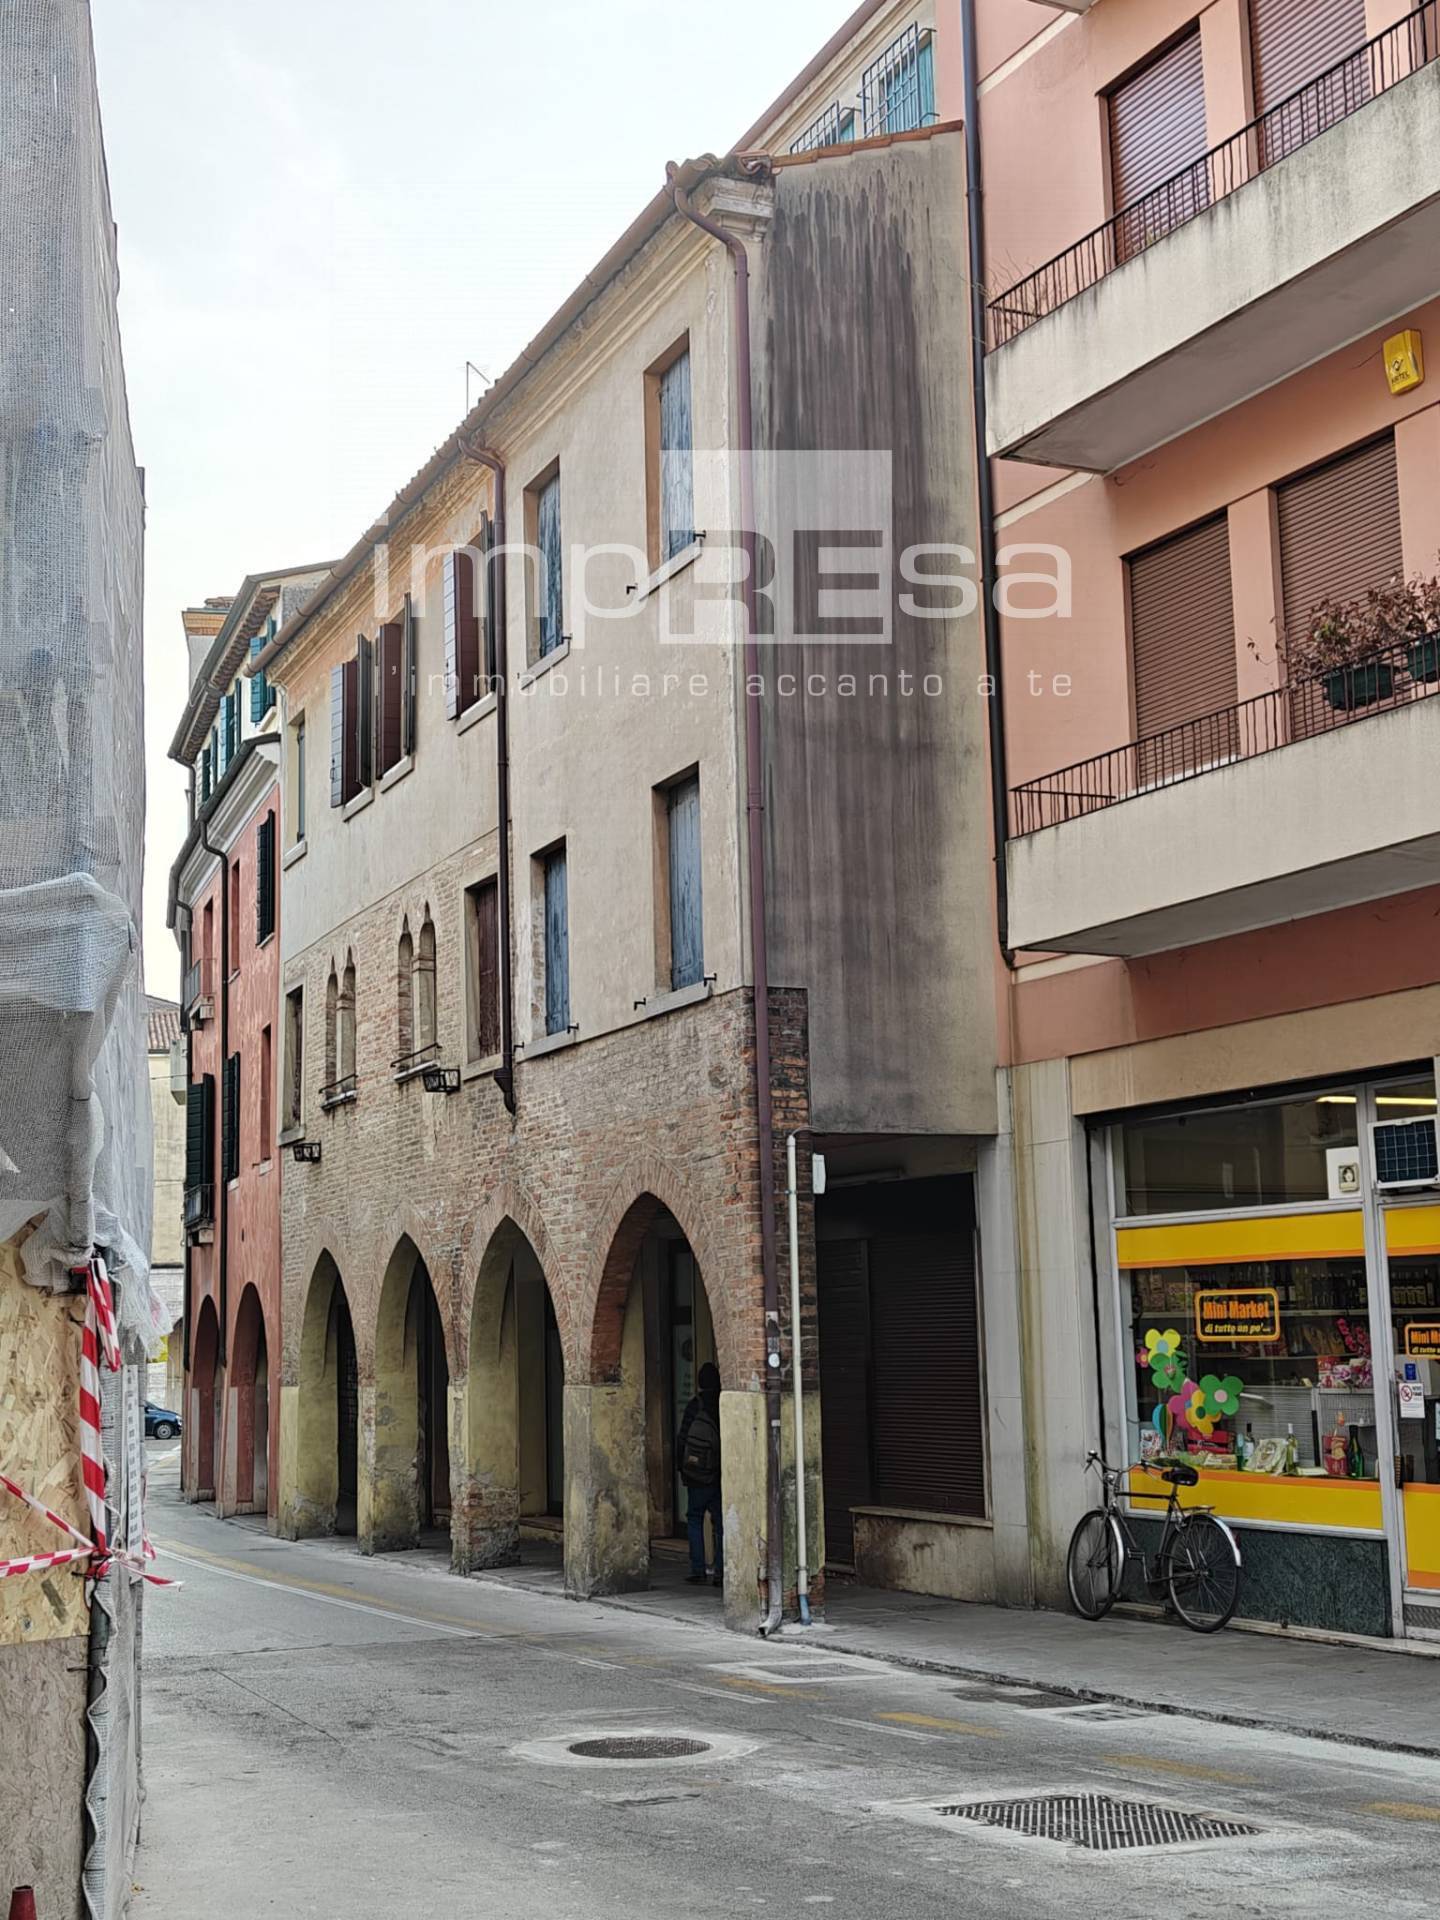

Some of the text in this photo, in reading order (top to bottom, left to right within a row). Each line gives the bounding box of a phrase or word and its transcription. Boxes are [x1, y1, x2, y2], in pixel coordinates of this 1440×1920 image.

[1203, 1300, 1269, 1319] Mini Market
[1205, 1323, 1213, 1333] di
[1215, 1324, 1236, 1333] tutto
[1237, 1324, 1249, 1333] un
[1411, 1330, 1430, 1344] Mini
